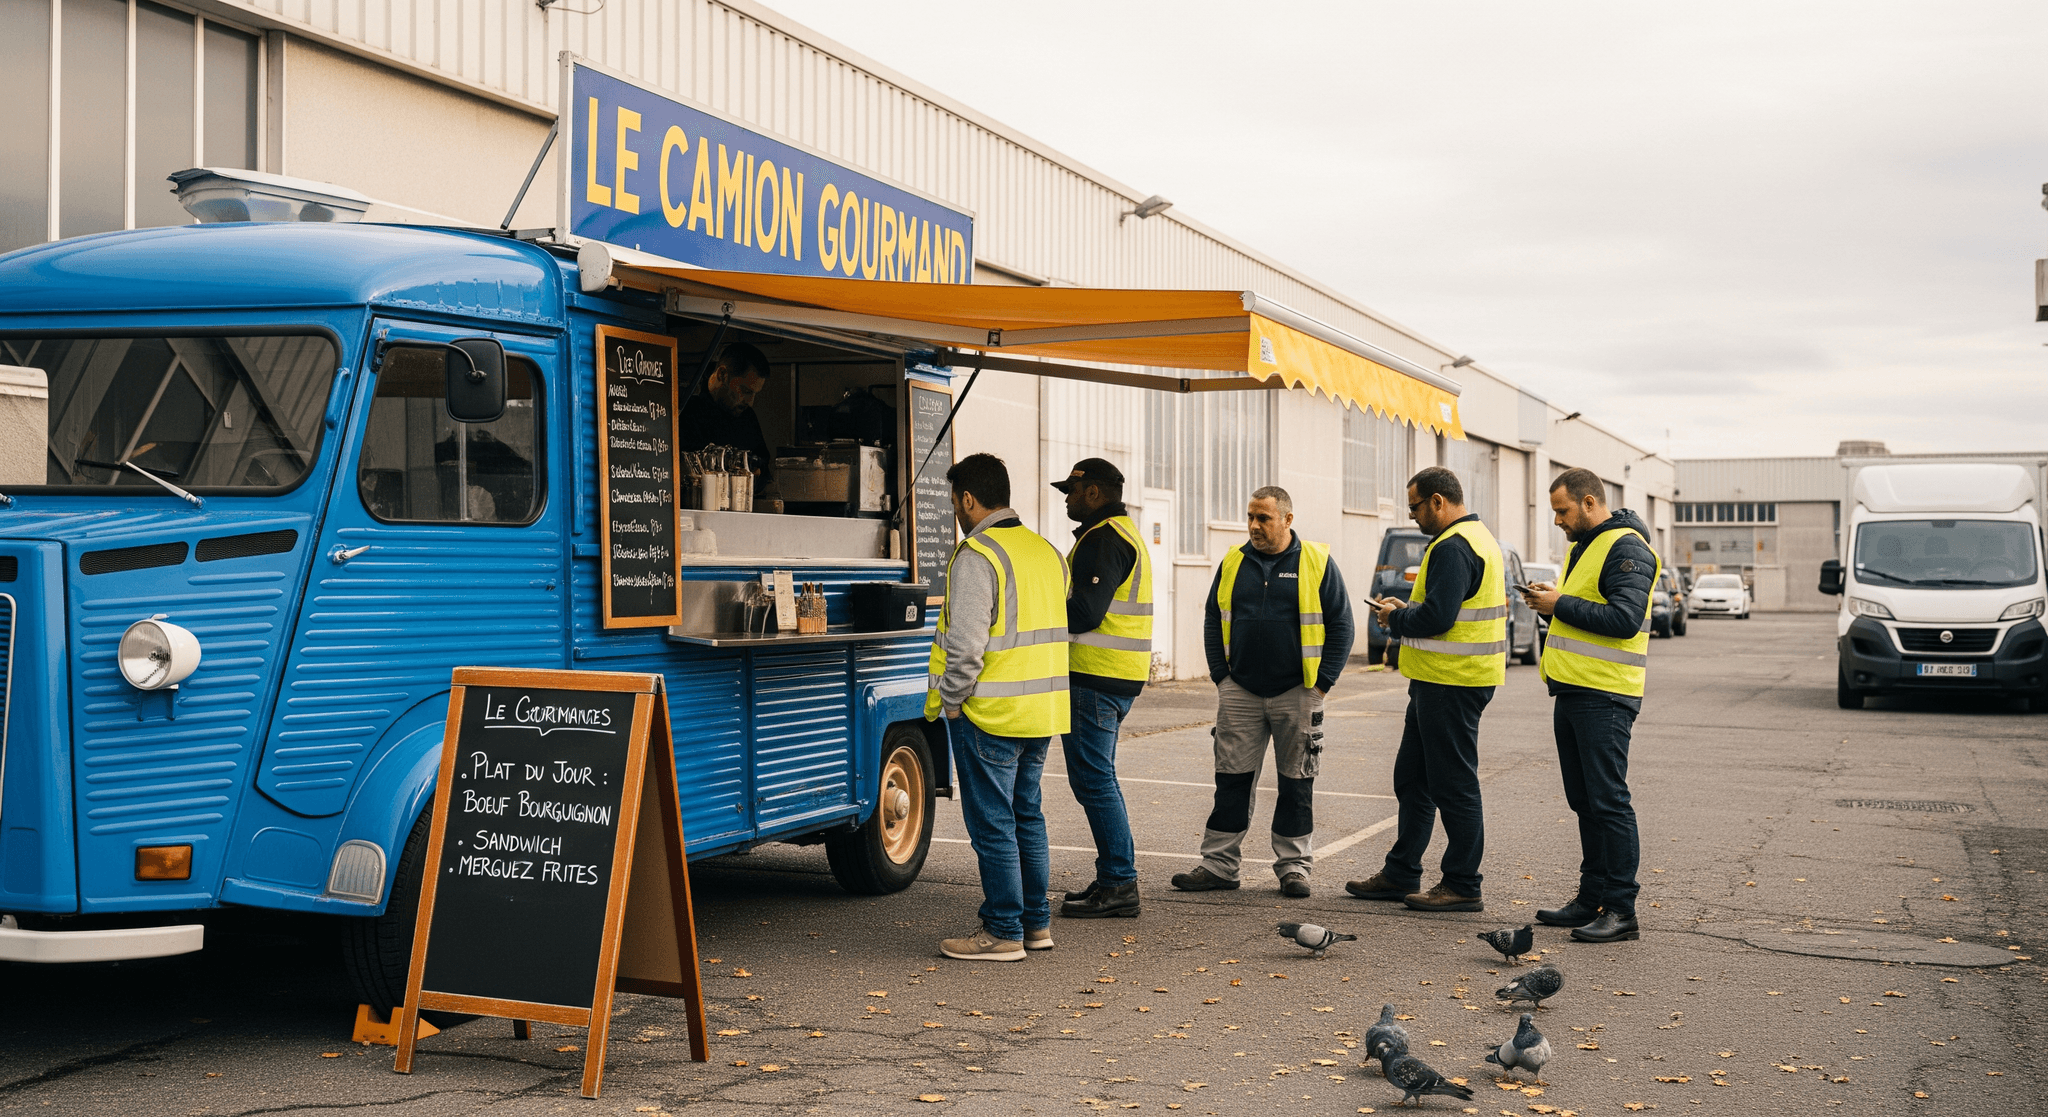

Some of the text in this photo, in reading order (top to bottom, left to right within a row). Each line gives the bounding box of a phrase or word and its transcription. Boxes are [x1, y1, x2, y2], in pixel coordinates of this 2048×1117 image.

[586, 96, 966, 284] LE CAMION GOURMAND
[484, 693, 506, 720] LE
[470, 751, 515, 780] PLAT
[525, 764, 544, 781] DU
[552, 760, 596, 786] JOUR
[462, 789, 611, 826] BOEUF BOURGUIGNON
[473, 829, 562, 856] SANDWICH
[458, 855, 598, 885] MERGUEZ FRITES
